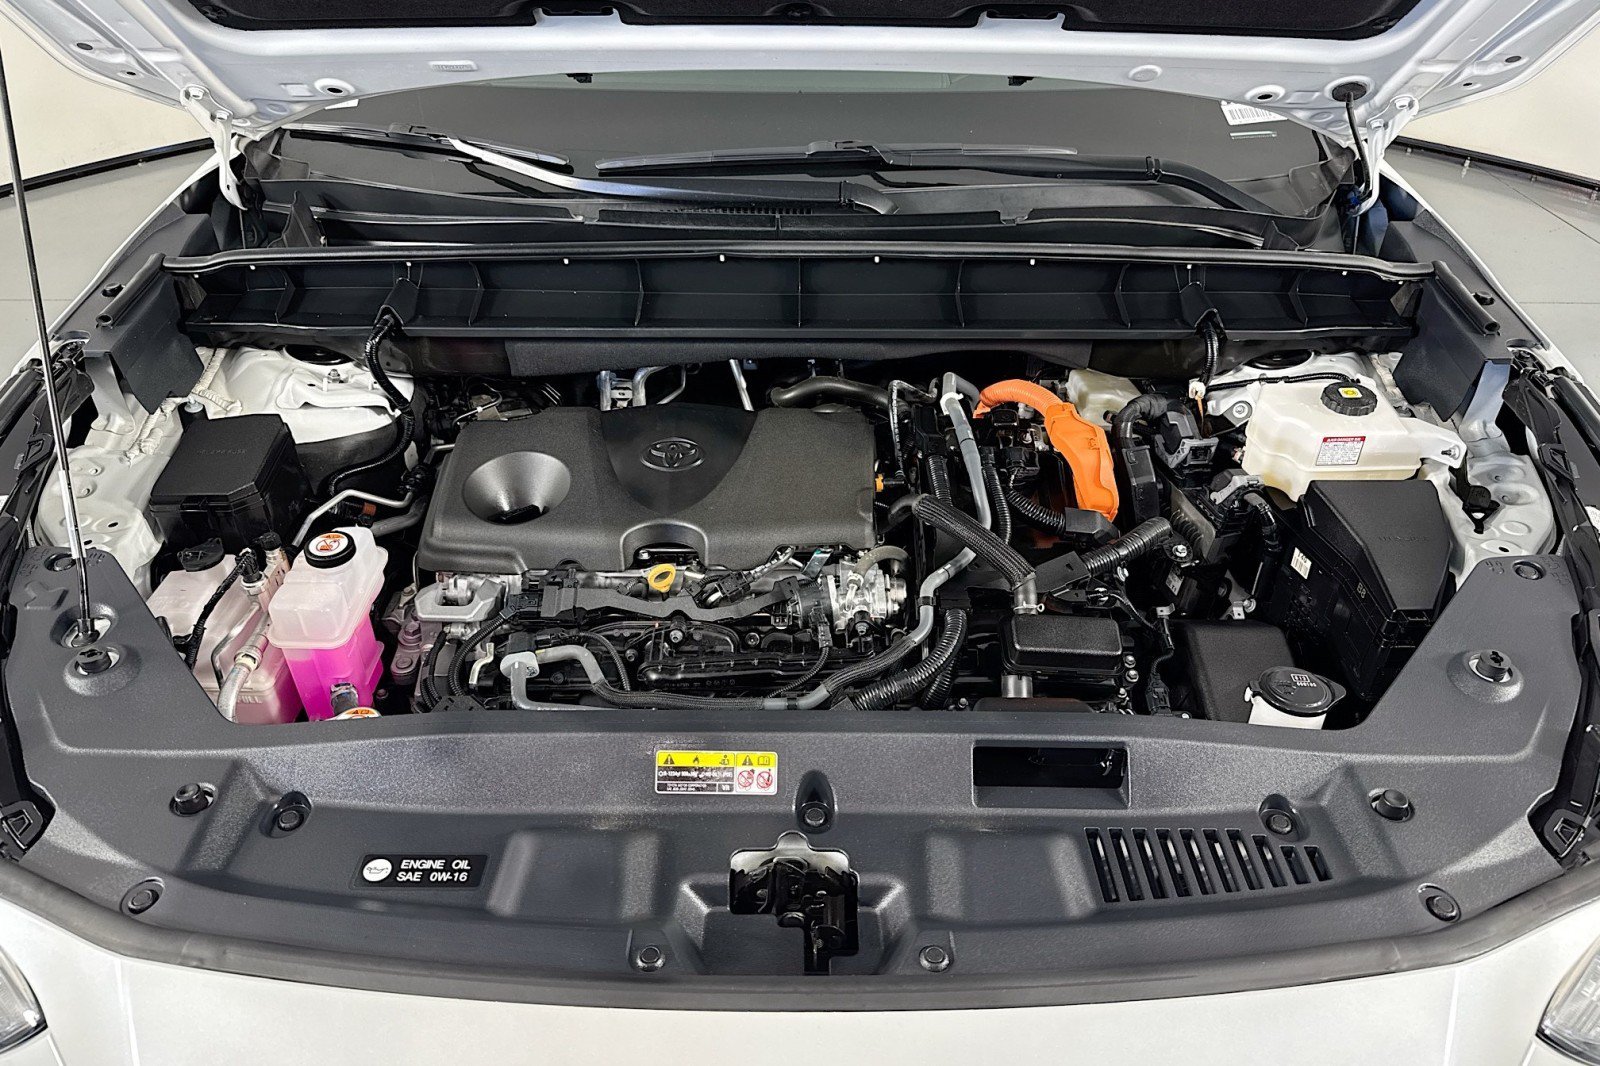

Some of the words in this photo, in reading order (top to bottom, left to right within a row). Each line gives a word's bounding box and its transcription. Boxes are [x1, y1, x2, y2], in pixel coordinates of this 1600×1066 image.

[400, 859, 446, 870] ENGINE
[451, 859, 471, 870] OIL
[396, 871, 423, 882] SAE
[429, 871, 468, 882] 0W-16
